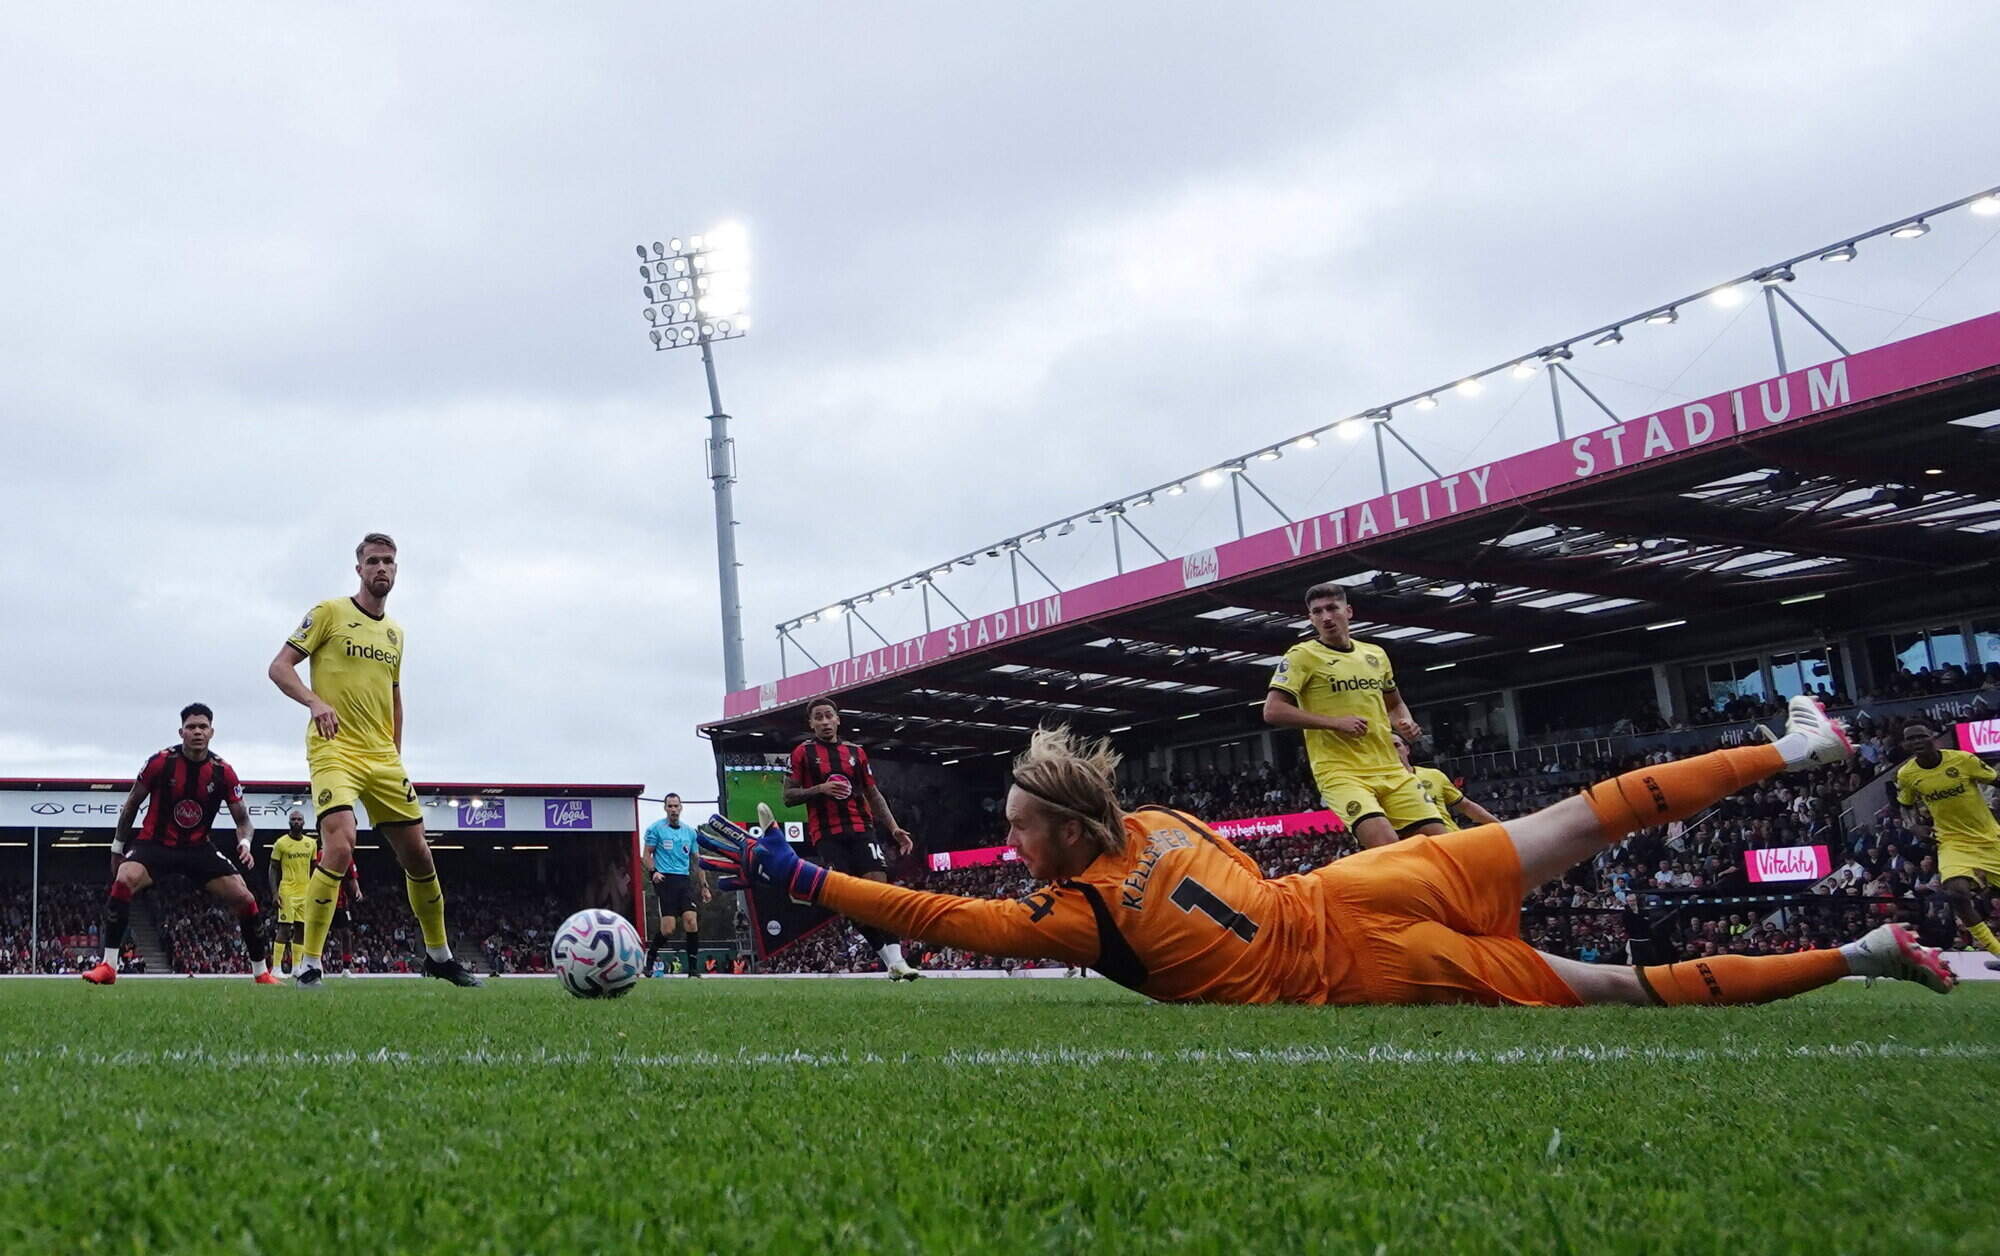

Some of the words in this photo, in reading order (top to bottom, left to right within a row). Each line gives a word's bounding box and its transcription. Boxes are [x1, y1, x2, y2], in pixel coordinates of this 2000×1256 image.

[1285, 465, 1491, 557] VITALITY
[1572, 360, 1850, 477] STADIUM
[829, 636, 927, 687] VITALITY
[948, 595, 1062, 653] STADIUM
[1329, 675, 1385, 692] indee
[72, 803, 149, 815] CHEY
[218, 805, 293, 816] CERY
[547, 803, 589, 826] Vegas
[1759, 848, 1814, 879] Vitality
[1168, 875, 1261, 944] 1
